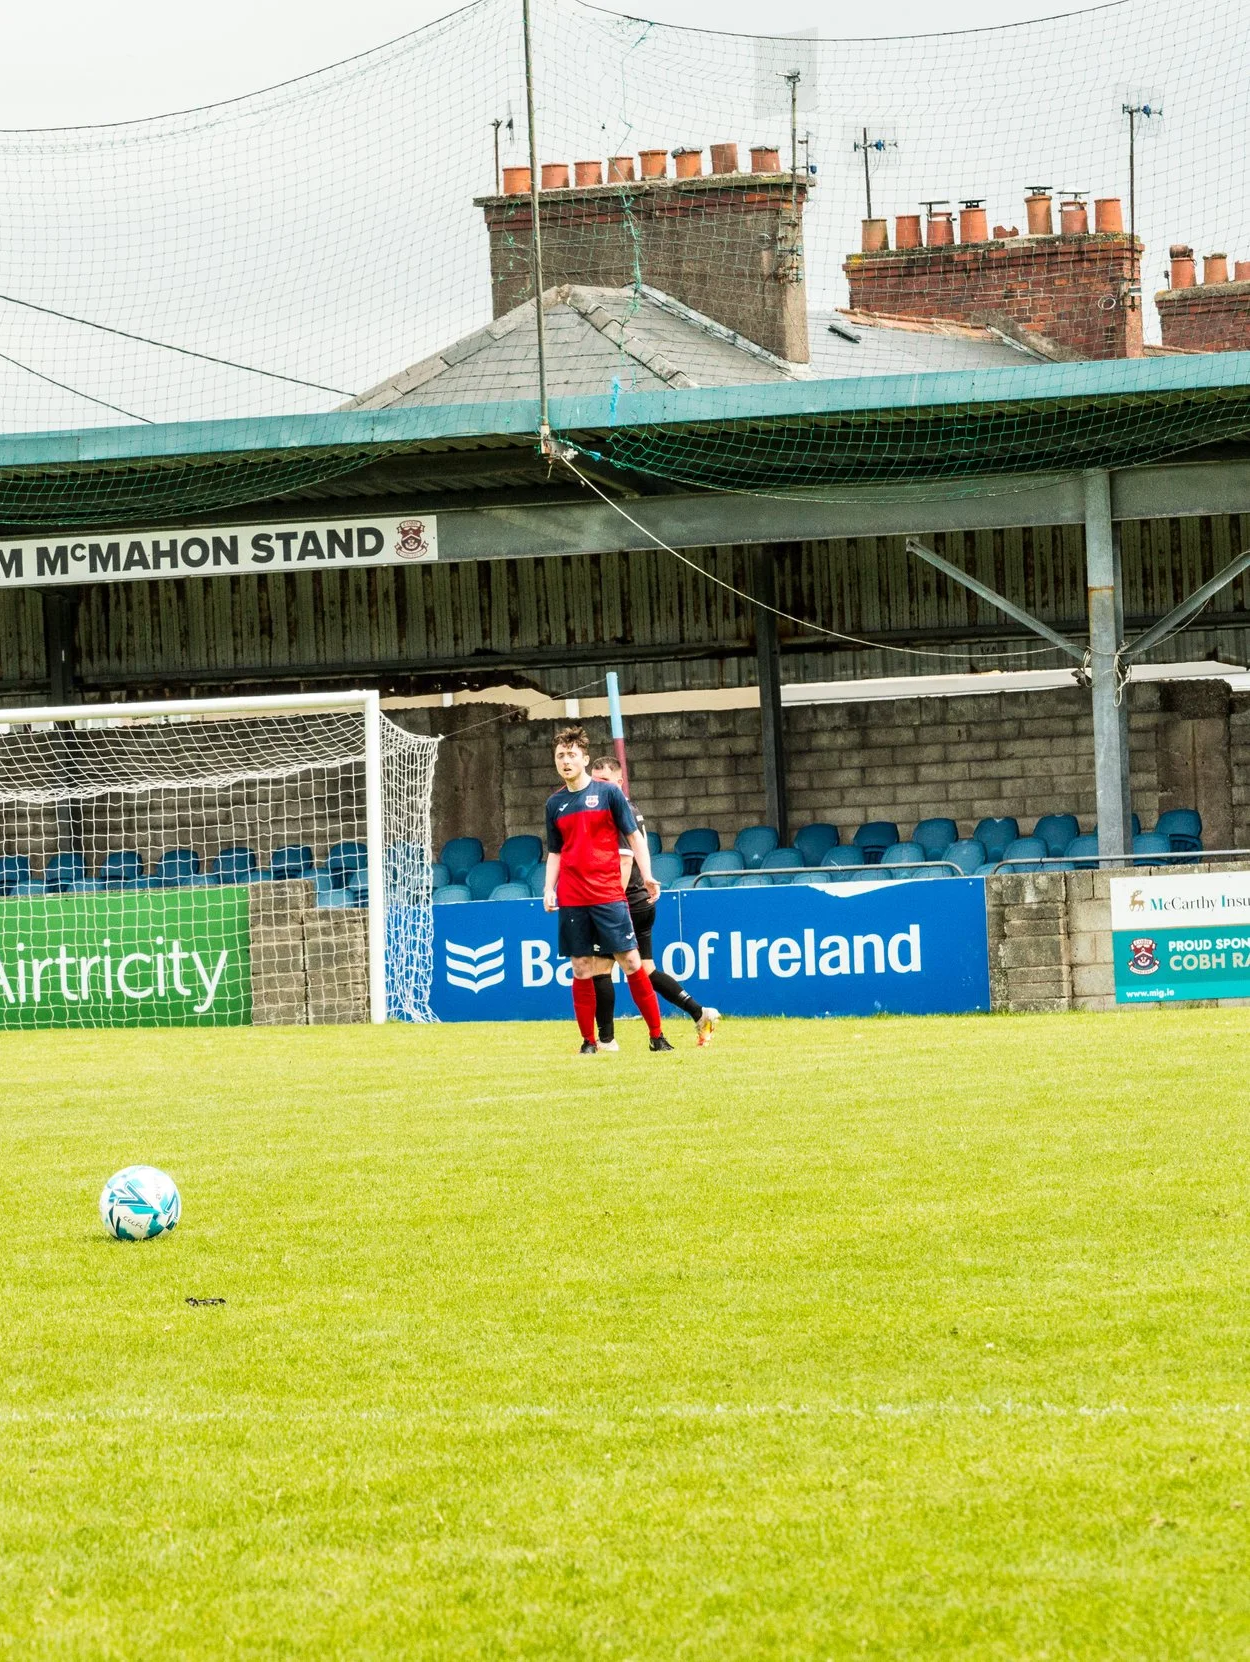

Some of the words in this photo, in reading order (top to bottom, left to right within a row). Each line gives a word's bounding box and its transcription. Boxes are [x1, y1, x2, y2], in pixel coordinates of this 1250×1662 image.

[250, 526, 385, 564] STAND
[1150, 896, 1217, 912] McCarthy
[662, 931, 720, 982] of
[730, 923, 922, 980] Ireland
[1168, 940, 1212, 952] PROUD
[1169, 953, 1226, 971] COBH
